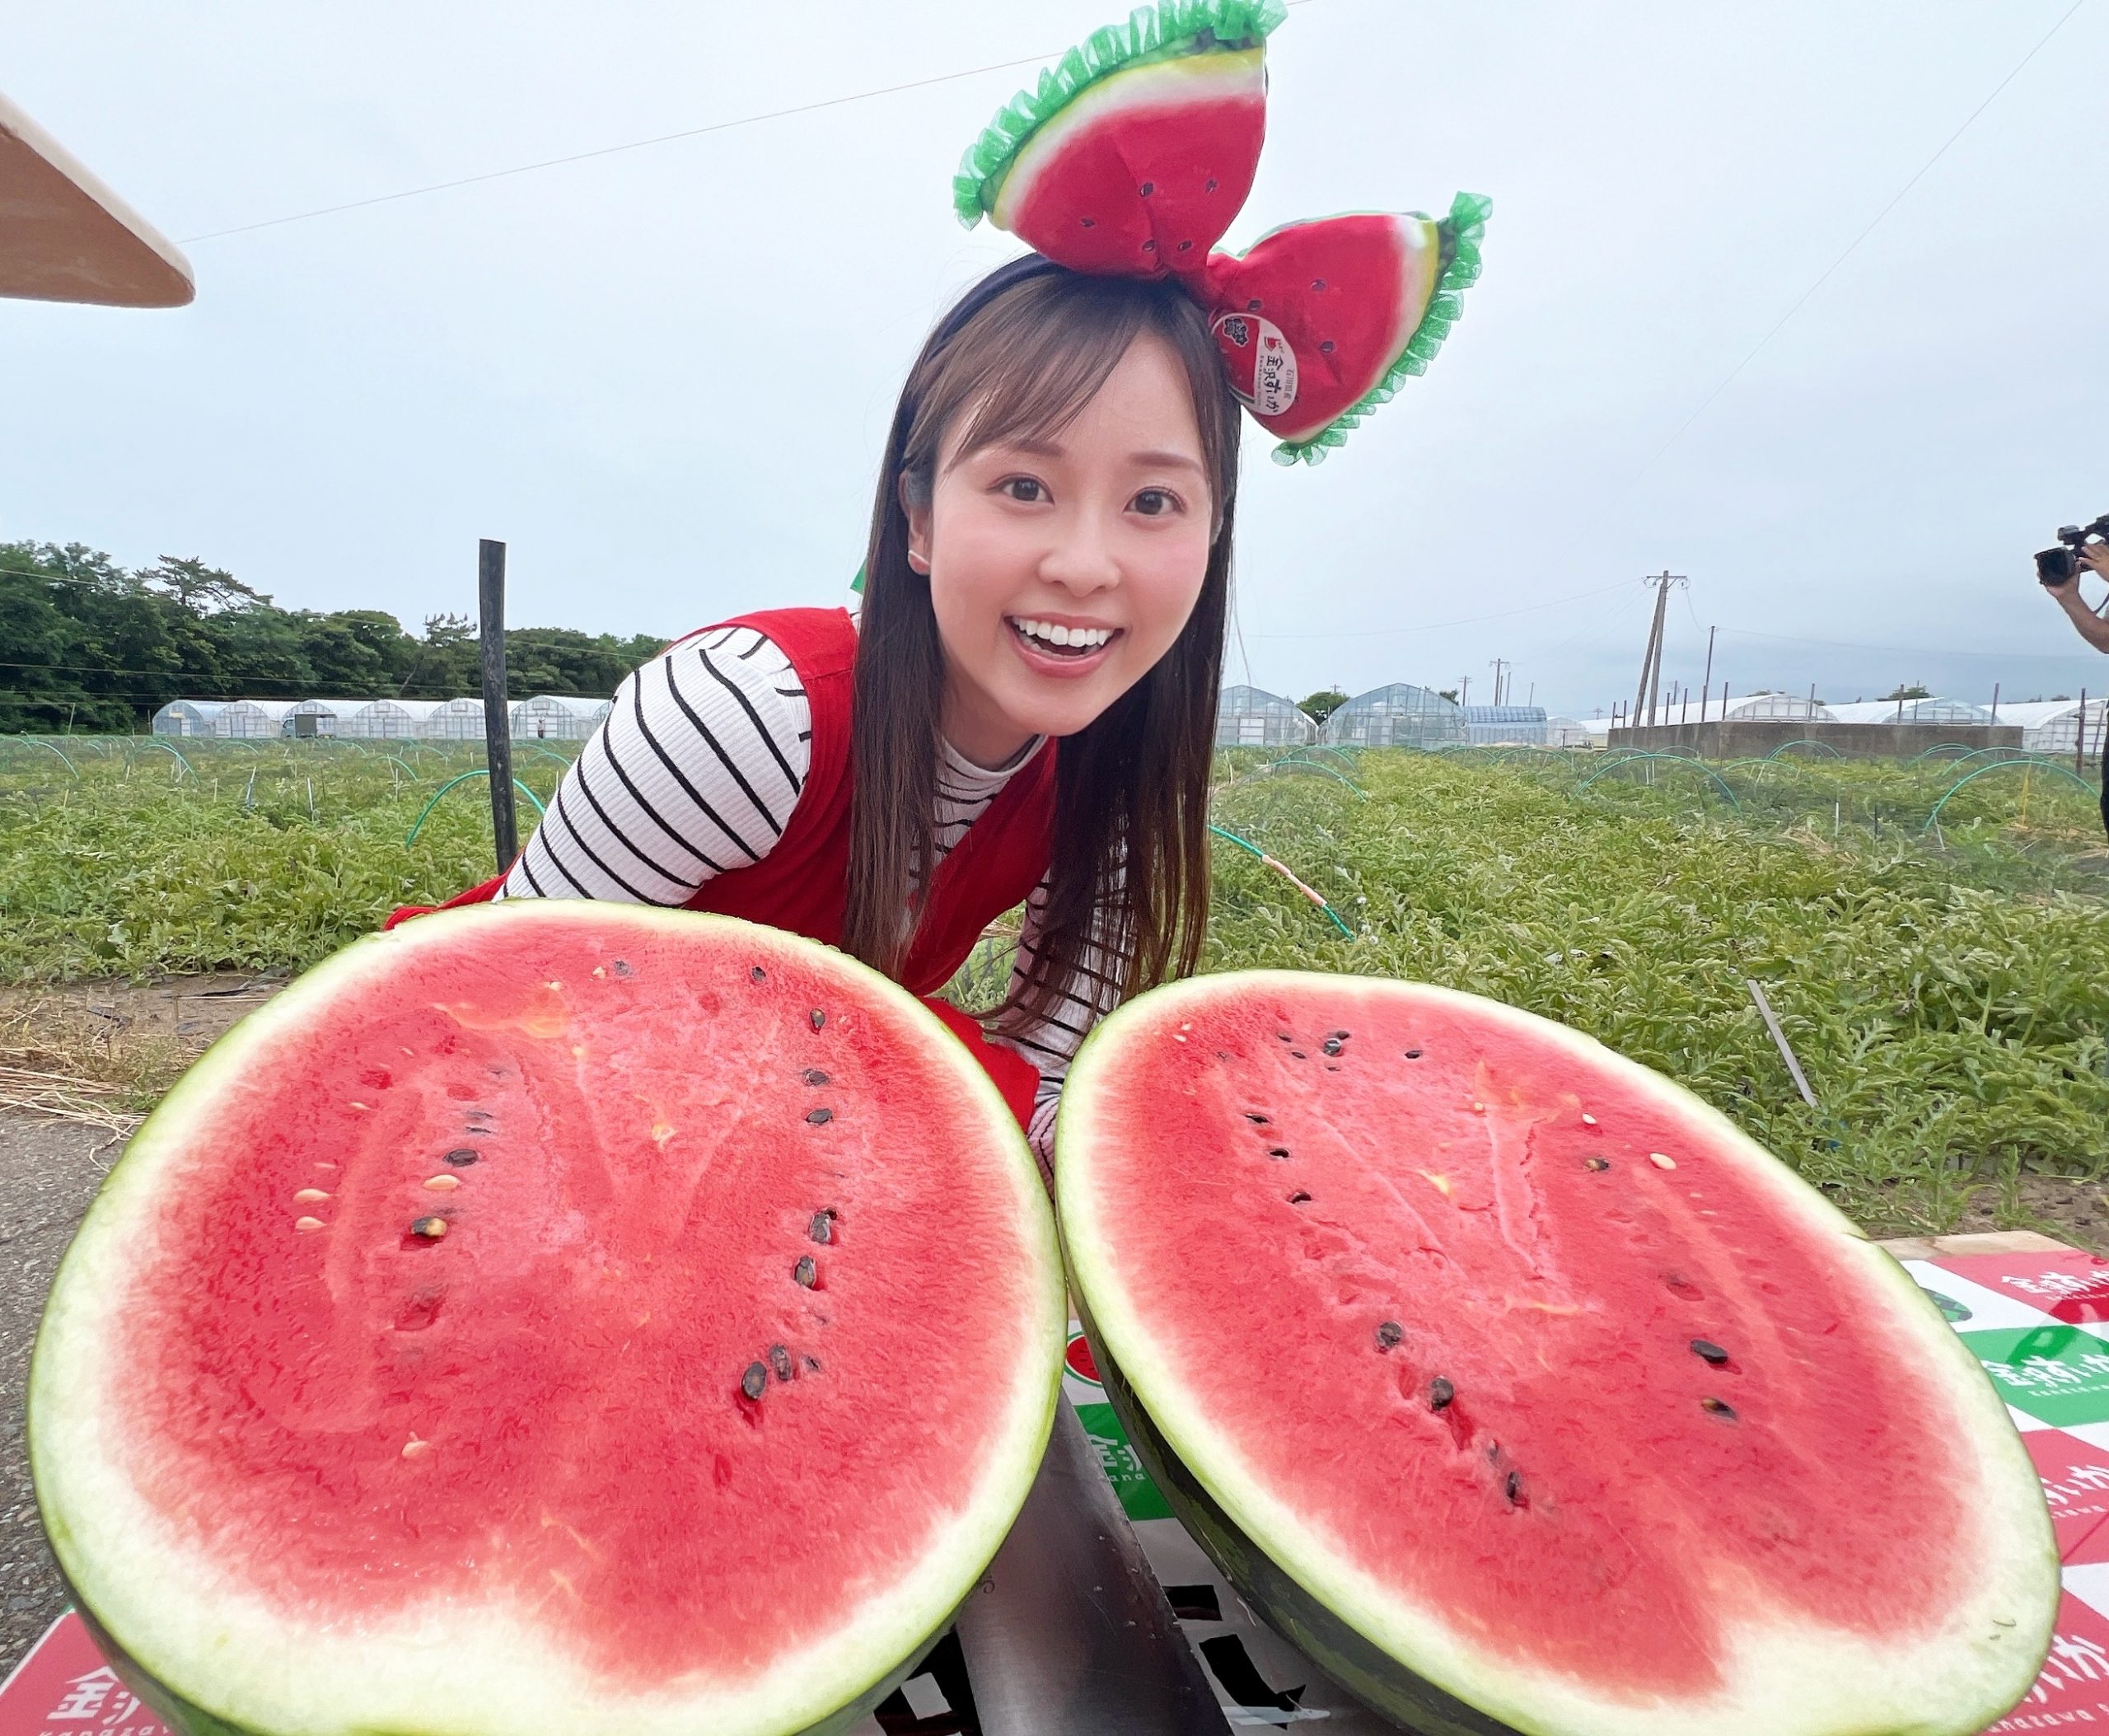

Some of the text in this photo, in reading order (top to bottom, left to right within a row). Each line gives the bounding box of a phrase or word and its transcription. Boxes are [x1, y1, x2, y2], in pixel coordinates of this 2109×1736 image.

[1263, 355, 1284, 413] 金沢すいか
